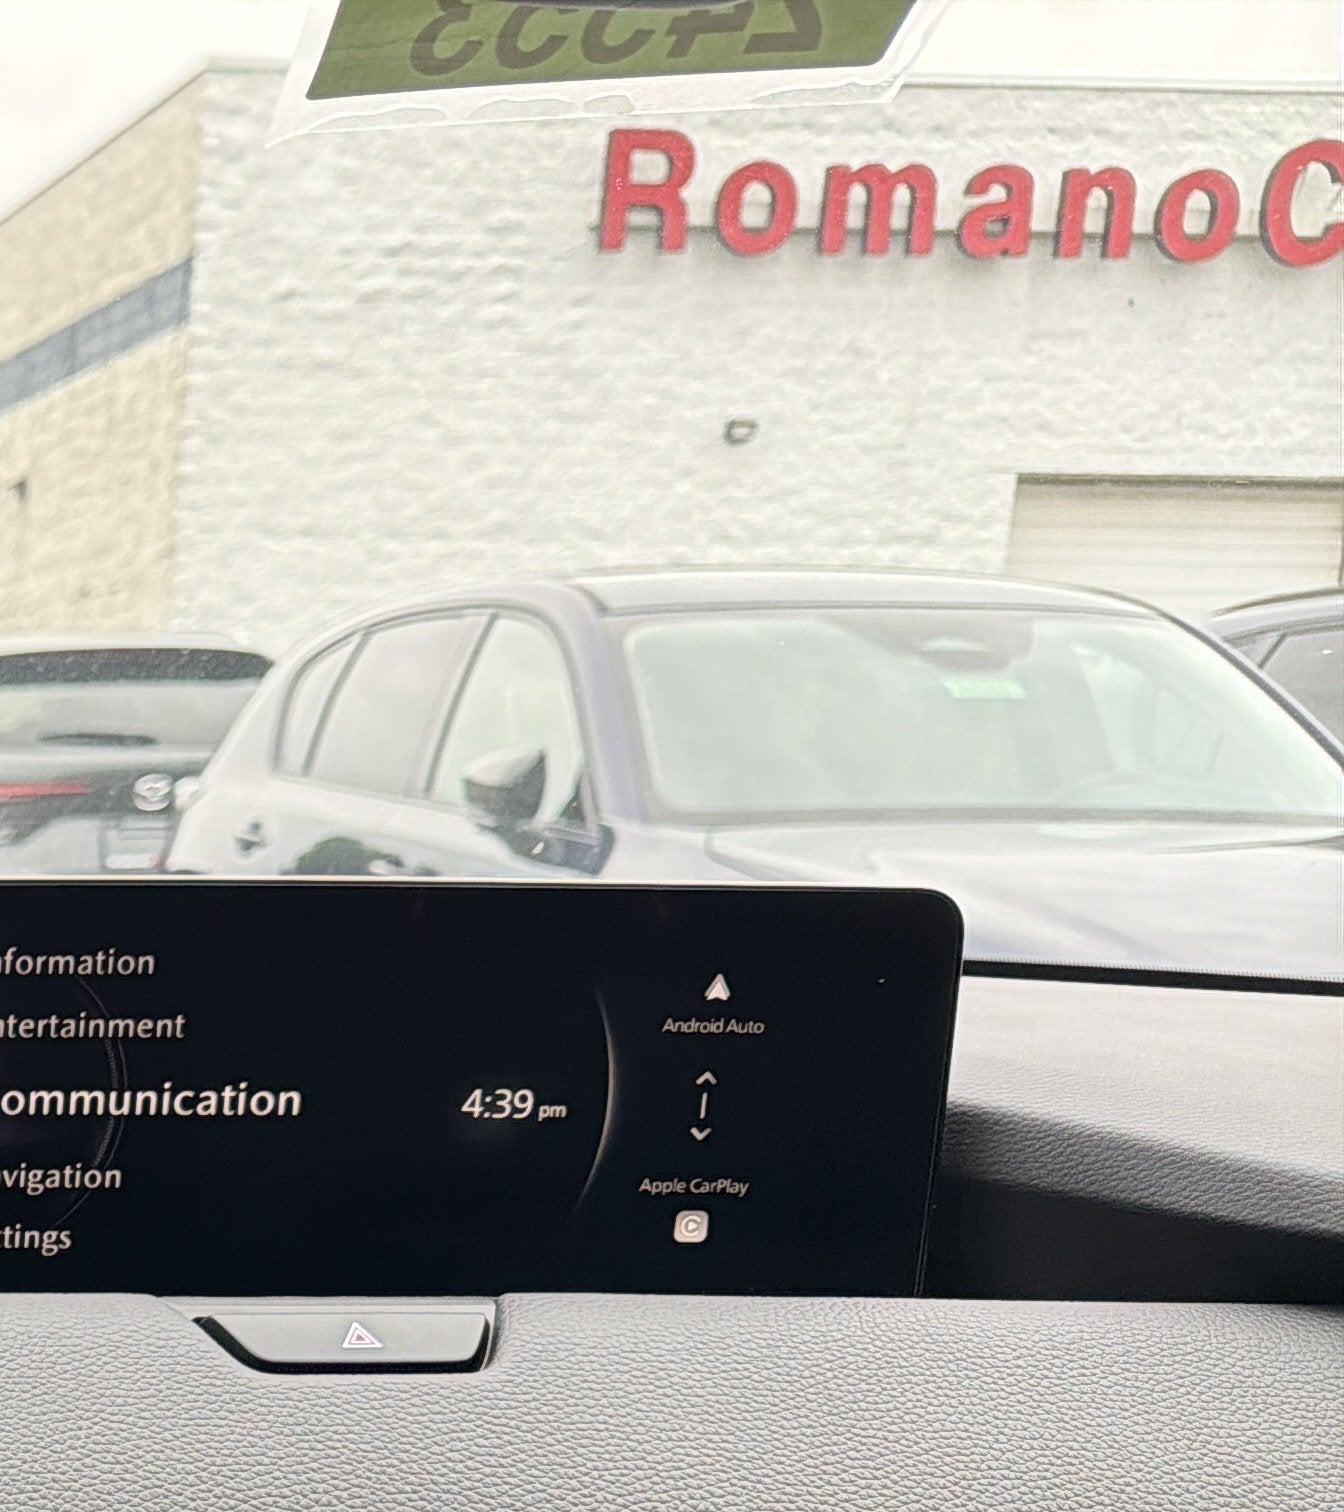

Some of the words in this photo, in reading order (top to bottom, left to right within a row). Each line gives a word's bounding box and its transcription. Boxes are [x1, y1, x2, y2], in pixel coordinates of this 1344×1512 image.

[662, 1018, 724, 1035] Android
[726, 1019, 765, 1035] Auto
[461, 1088, 535, 1120] 4:39
[537, 1103, 568, 1122] pm
[638, 1178, 686, 1197] Apple
[688, 1178, 750, 1198] CarPlay
